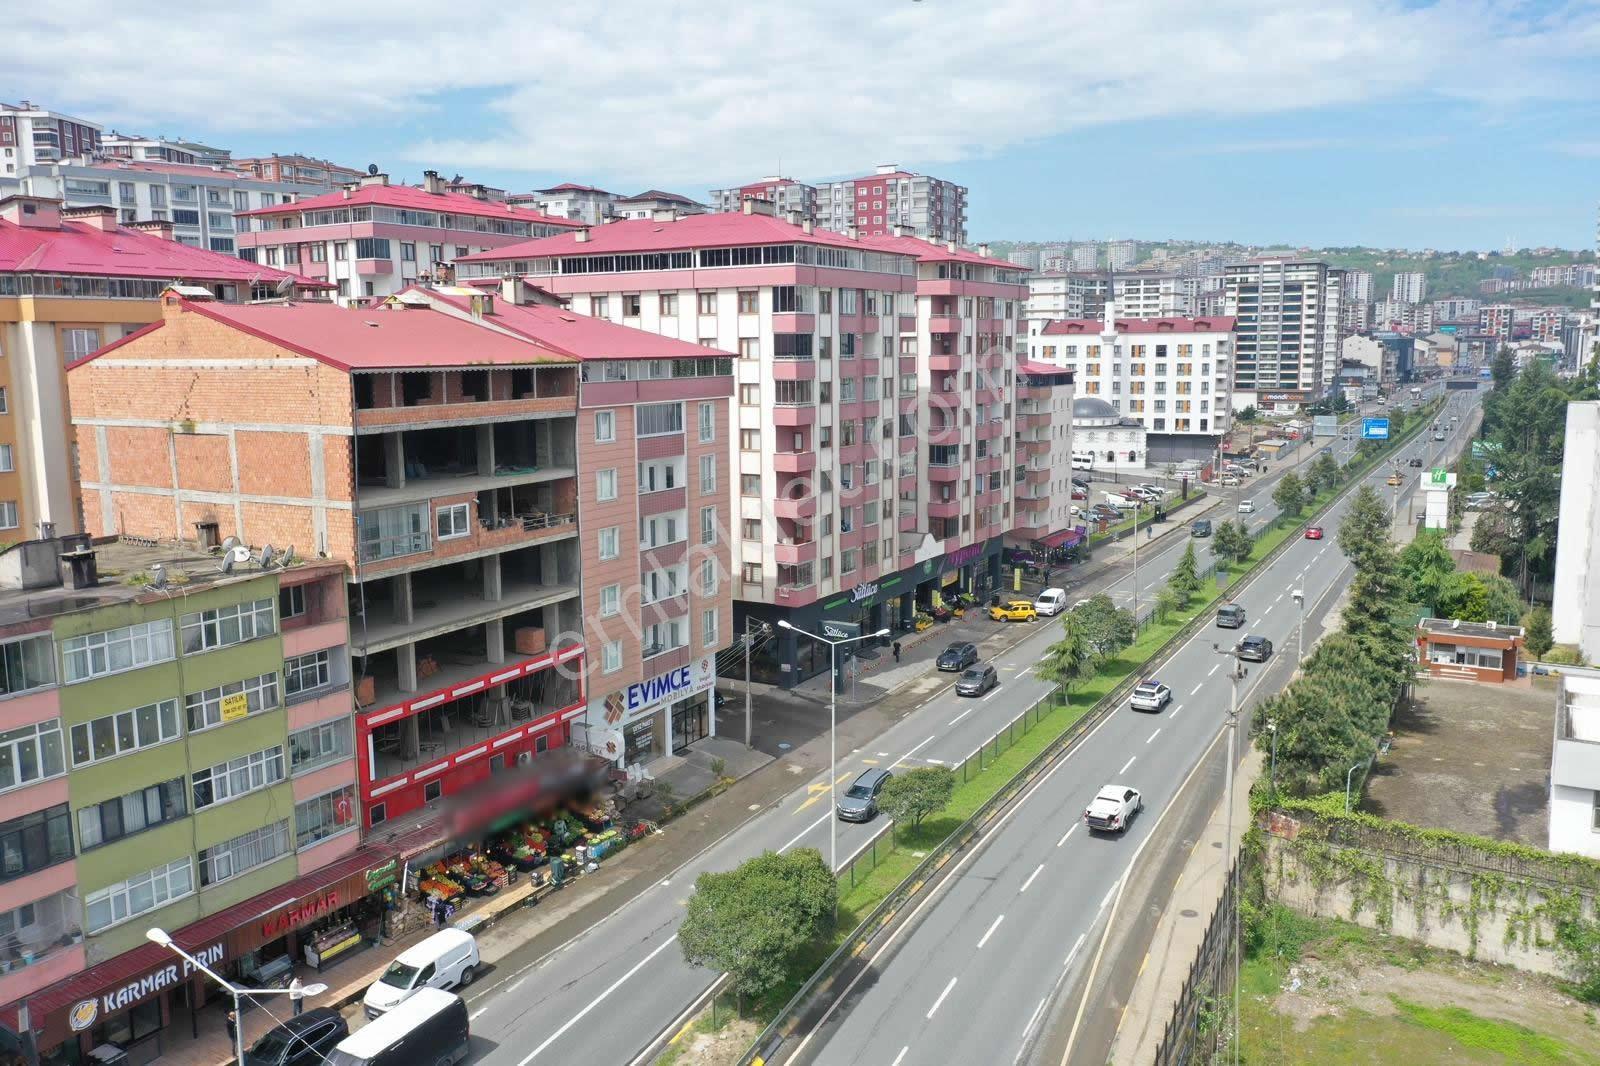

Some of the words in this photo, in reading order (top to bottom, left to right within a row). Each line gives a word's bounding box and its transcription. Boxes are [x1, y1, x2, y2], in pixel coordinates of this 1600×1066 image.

[262, 889, 338, 938] KARMAR
[103, 964, 179, 1014] KARMAR
[183, 943, 224, 978] FIRIN
